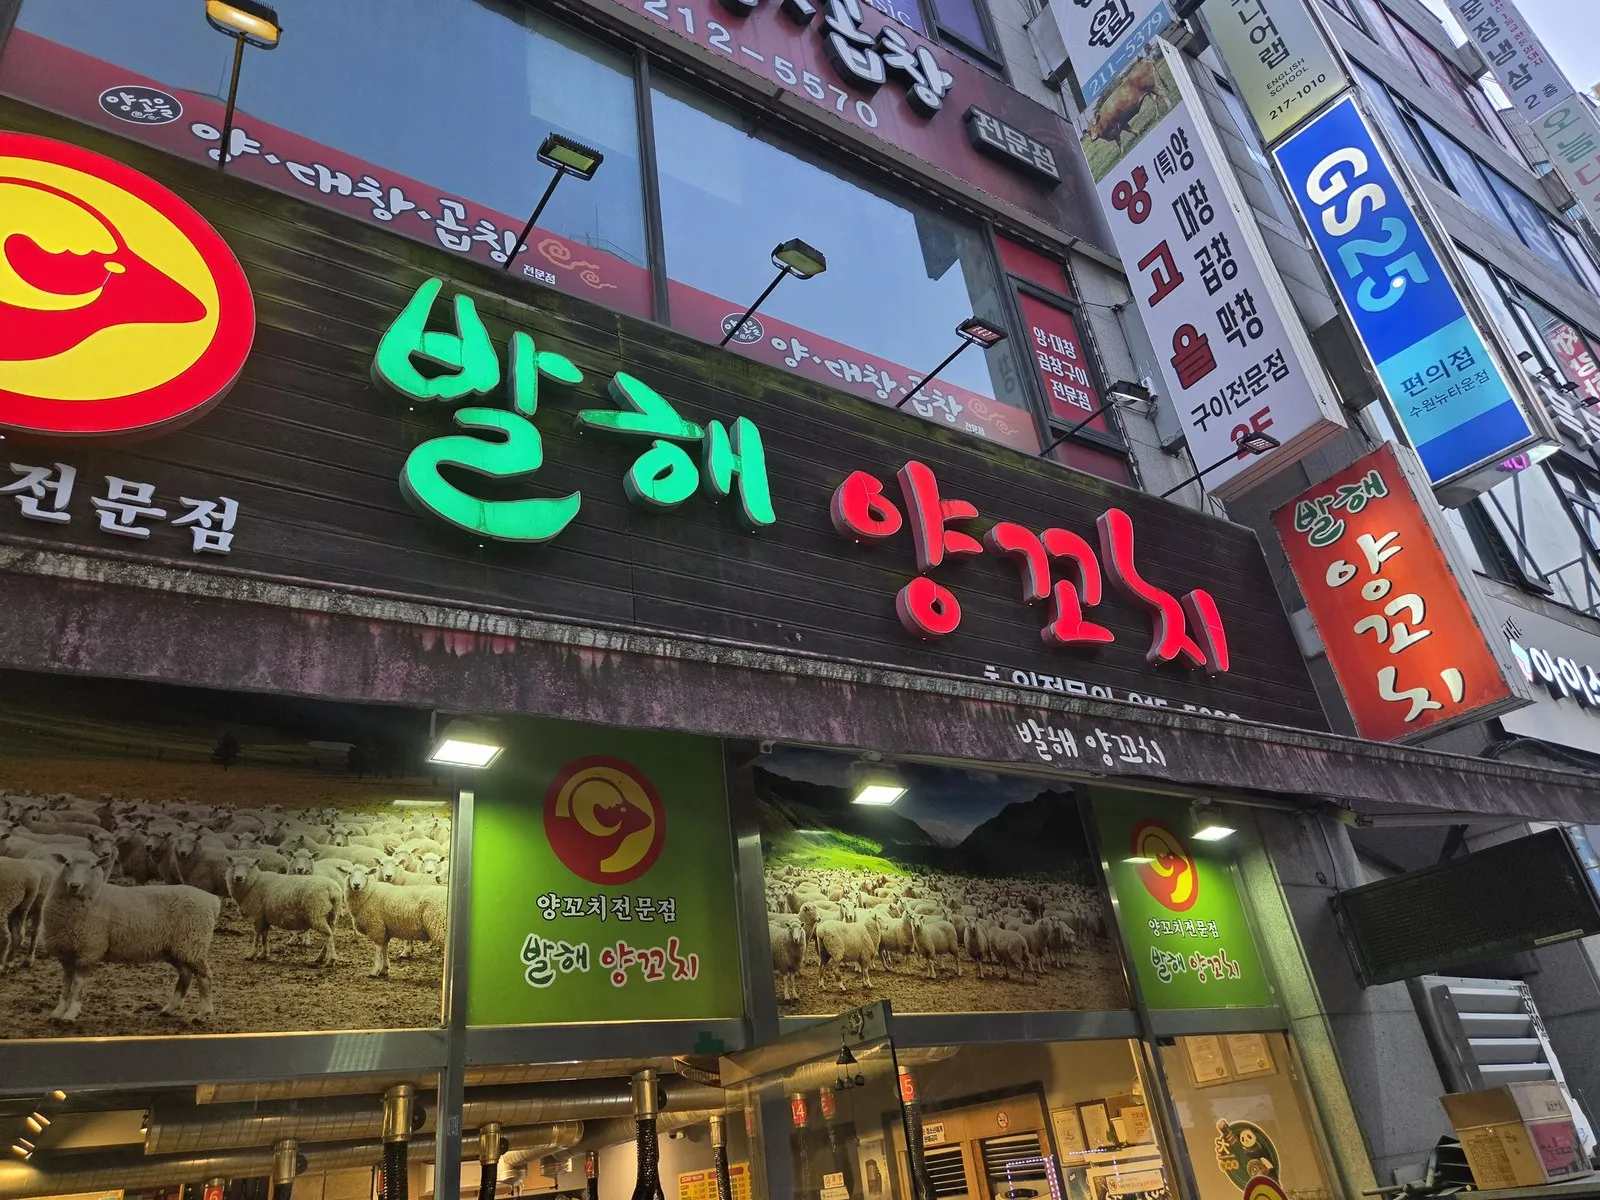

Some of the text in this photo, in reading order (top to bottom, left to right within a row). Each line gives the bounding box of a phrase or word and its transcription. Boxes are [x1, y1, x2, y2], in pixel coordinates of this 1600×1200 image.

[1089, 11, 1163, 97] 211-5379
[1266, 58, 1305, 90] ENGLISH
[1270, 66, 1309, 97] SCHOOL
[1269, 73, 1326, 120] 217-1010
[973, 108, 1060, 179] 전문점
[1153, 127, 1194, 184] (특)양
[1172, 178, 1217, 242] 대창
[1306, 147, 1430, 312] GS25
[523, 263, 556, 285] 전문점
[1194, 231, 1238, 296] 곱창
[1216, 288, 1264, 348] 막창
[1036, 350, 1090, 388] 곱창구이
[1050, 379, 1092, 412] 전문점
[1190, 348, 1290, 432] 구이전문점
[1401, 346, 1476, 397] 편의점
[1410, 369, 1490, 418] 수원뉴타운점
[370, 277, 1230, 673] 발해 양꼬치
[0, 462, 239, 555] 전문점
[1294, 470, 1389, 547] 발해
[1326, 531, 1464, 722] 양꼬치
[1529, 646, 1600, 706] 아이
[1016, 718, 1167, 767] 발해 양꼬치
[536, 892, 677, 923] 양꼬치전문점
[1148, 917, 1220, 939] 양꼬치전문점
[520, 933, 699, 988] 발해 양꼬치
[1150, 946, 1241, 983] 발해 양꼬치
[791, 1104, 805, 1120] 14
